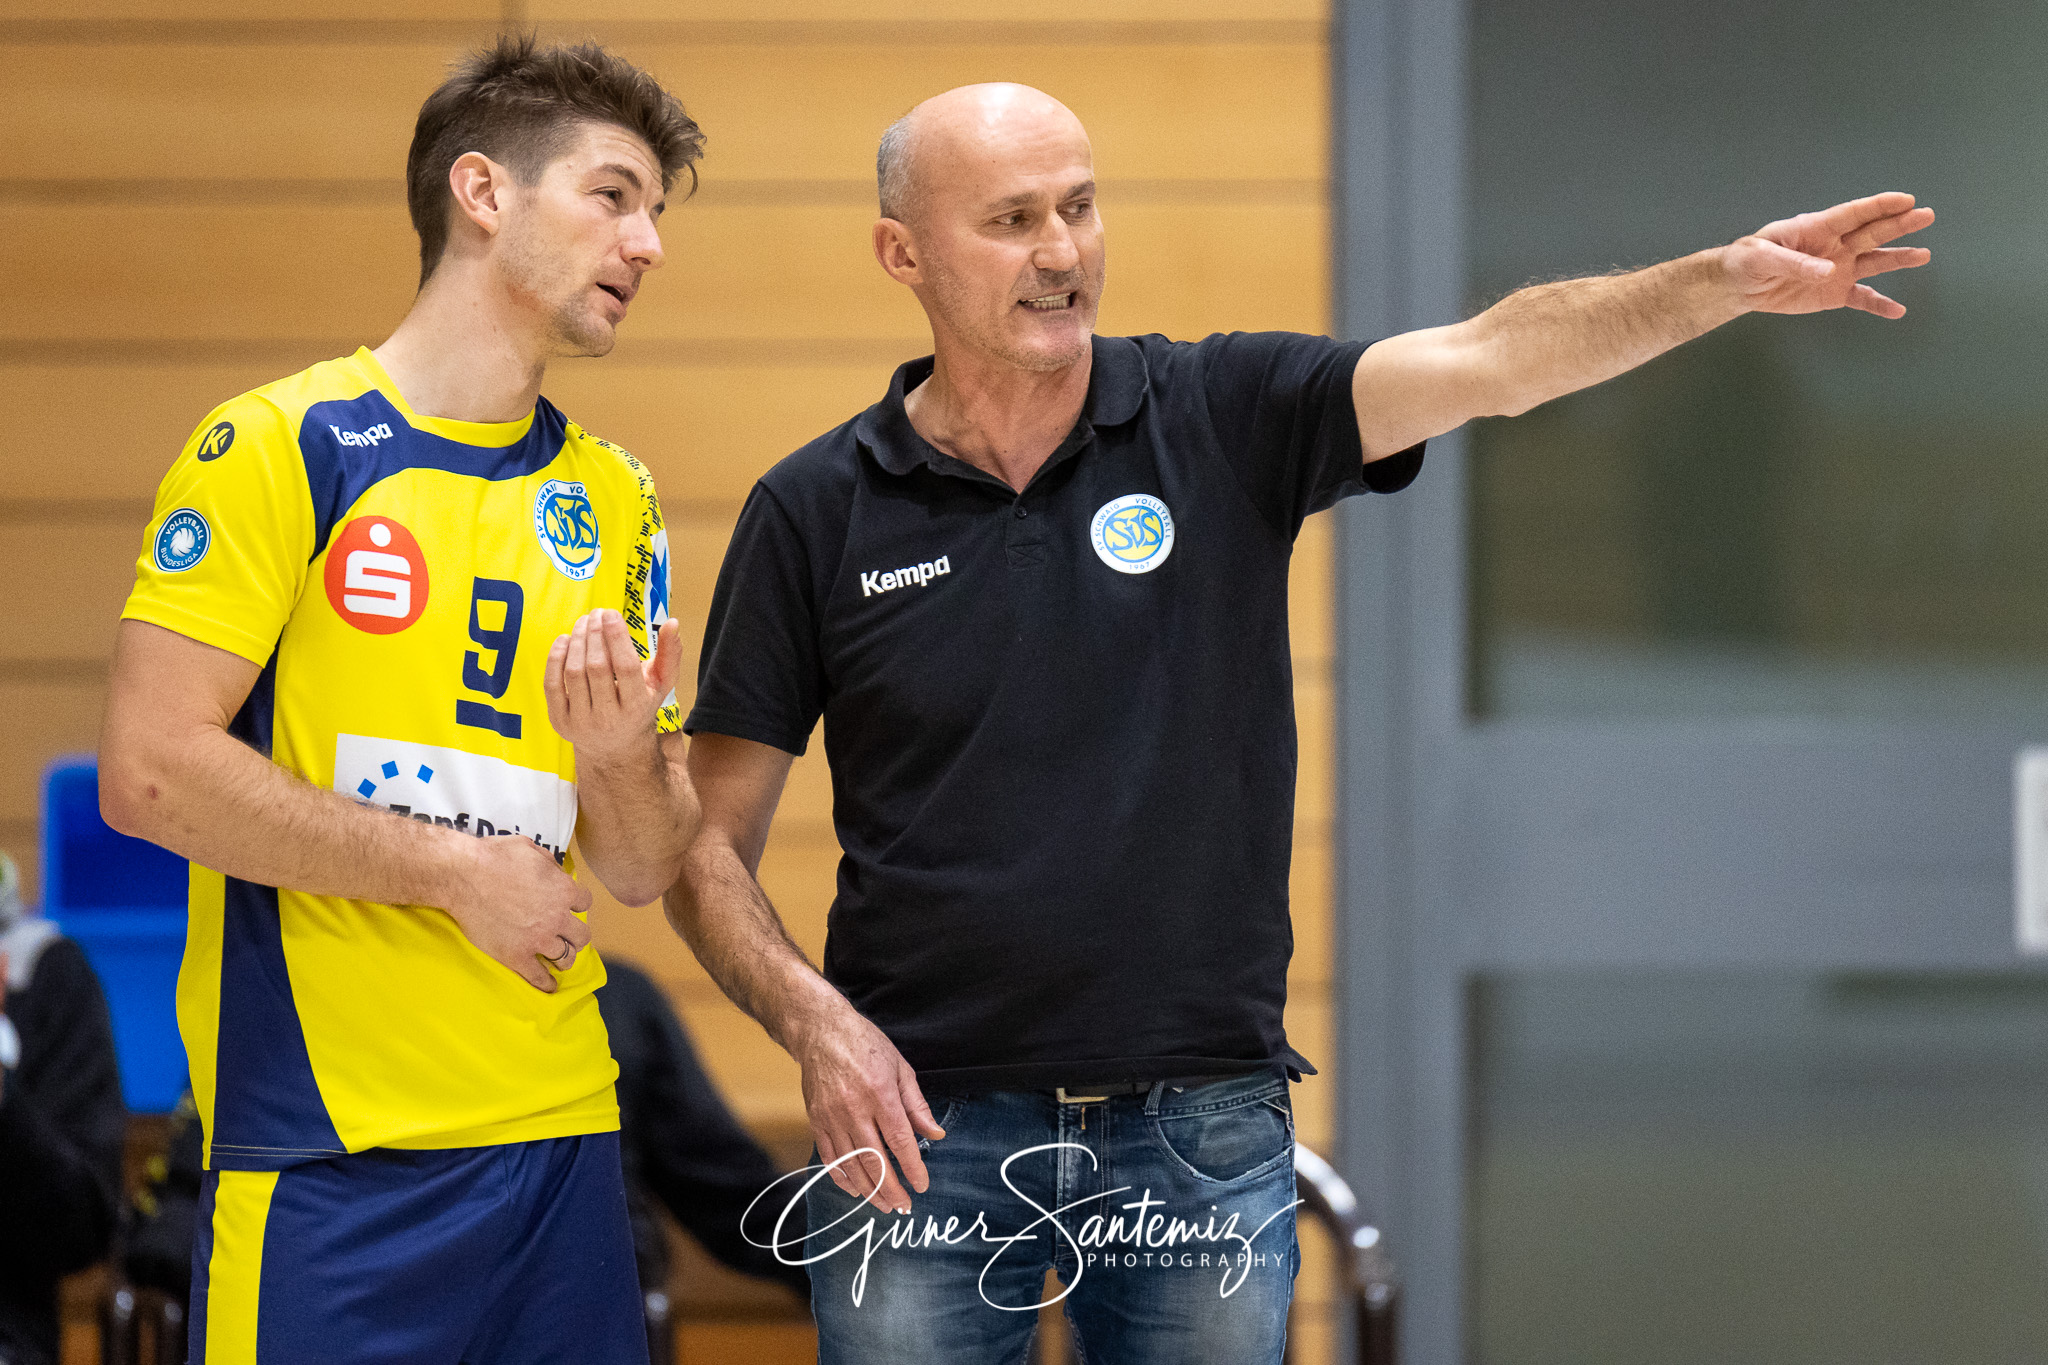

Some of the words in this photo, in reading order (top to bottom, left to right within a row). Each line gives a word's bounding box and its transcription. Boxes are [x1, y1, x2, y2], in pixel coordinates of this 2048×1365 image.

[328, 423, 394, 448] Kempa
[536, 483, 558, 521] SCHWAI
[165, 516, 204, 540] VOLLEYBALL
[1094, 503, 1120, 537] SCHWAIG
[1135, 498, 1172, 539] VOLLEYBALL
[537, 525, 546, 539] SV
[160, 547, 199, 567] BUNDESLIGA
[1096, 540, 1105, 551] SV
[565, 565, 586, 577] 1967
[860, 555, 951, 597] Kempa
[1129, 561, 1150, 570] 1967
[462, 576, 524, 699] 9
